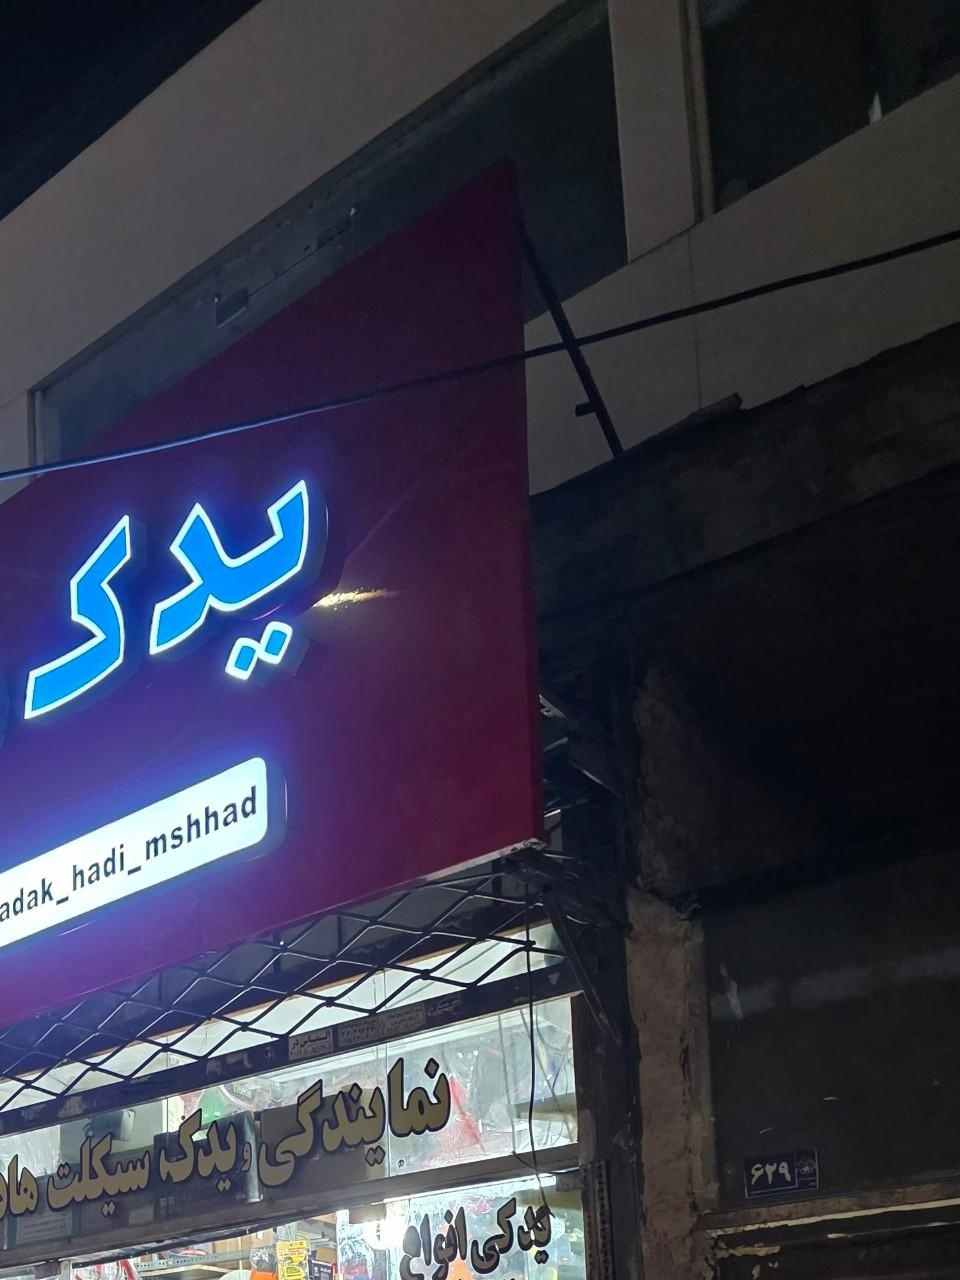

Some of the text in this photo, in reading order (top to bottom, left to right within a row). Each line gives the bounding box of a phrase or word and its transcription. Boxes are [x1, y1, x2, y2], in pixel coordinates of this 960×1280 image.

[23, 479, 311, 720] یدک
[158, 1108, 240, 1193] یدک
[257, 1056, 453, 1187] نمایندگی
[46, 1133, 151, 1216] سیکلت
[751, 1161, 791, 1185] ۶۲۹
[470, 1197, 552, 1275] یدکی
